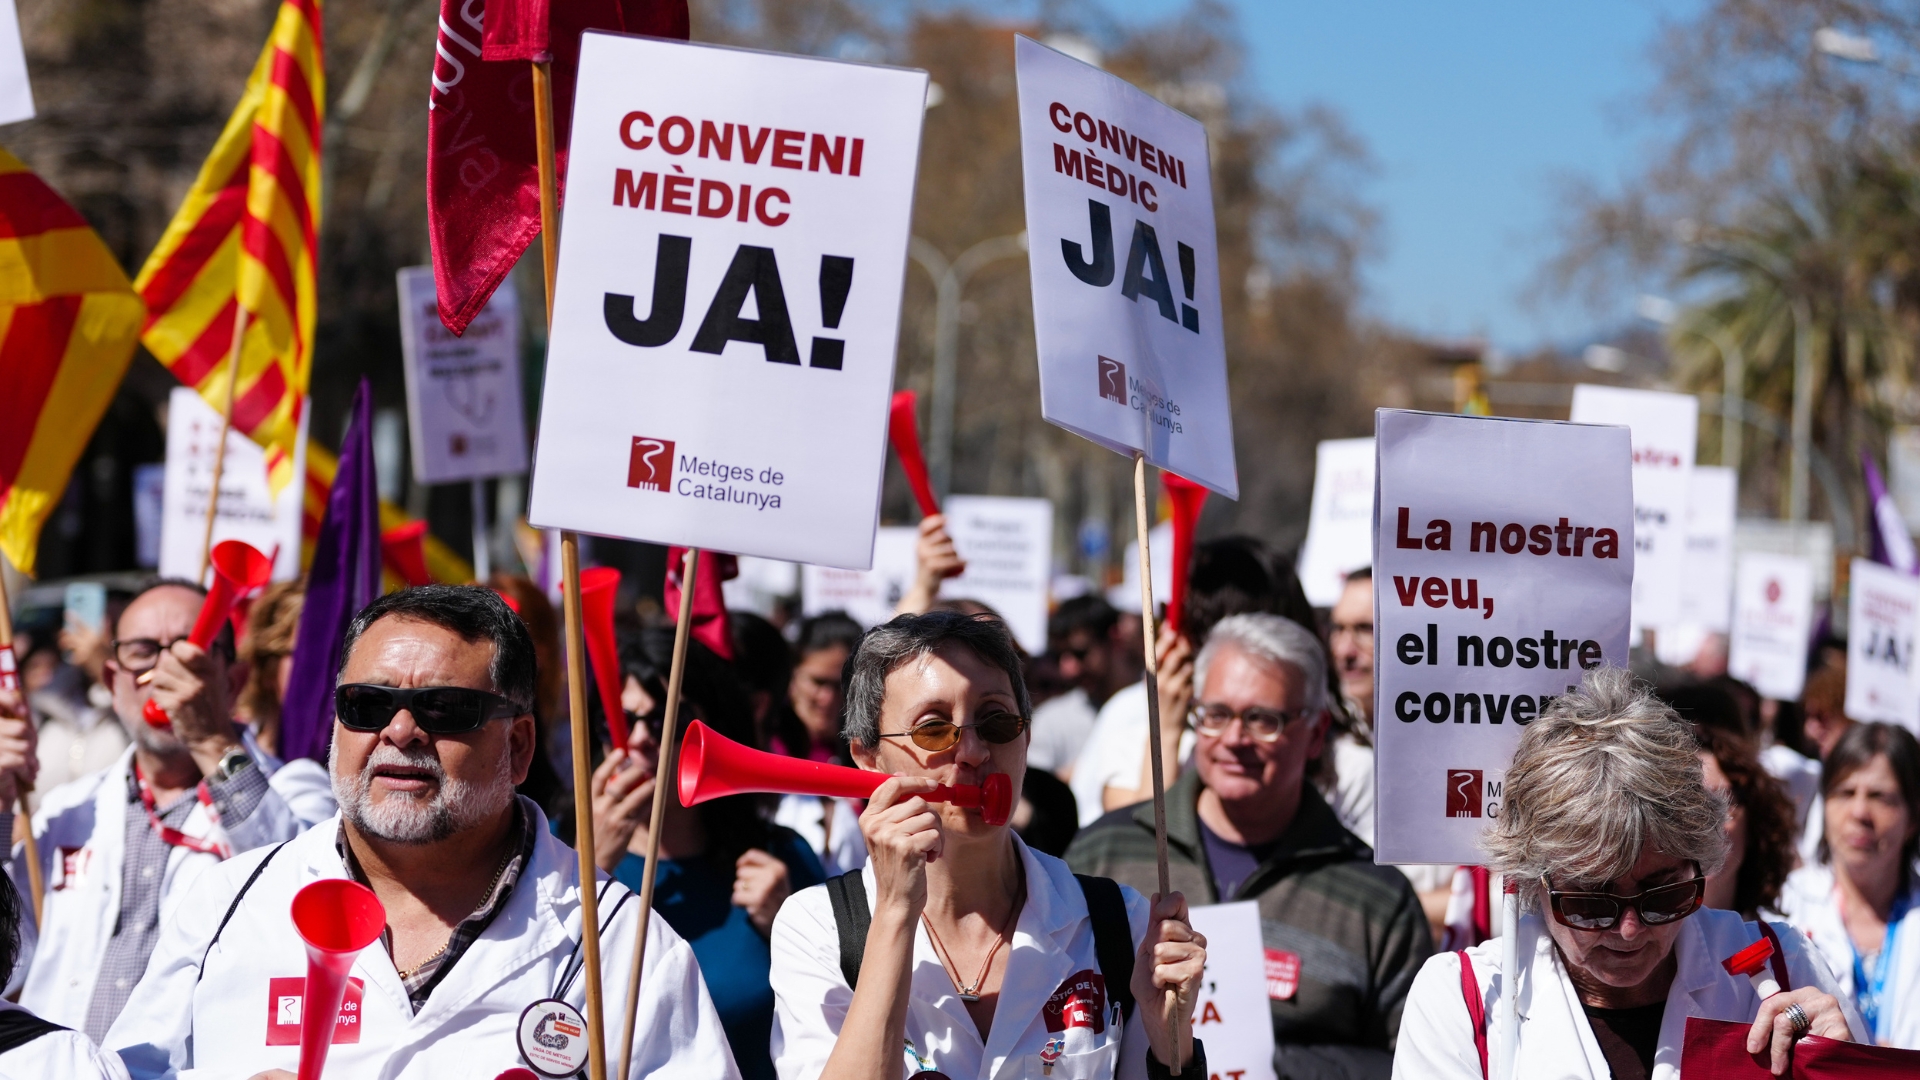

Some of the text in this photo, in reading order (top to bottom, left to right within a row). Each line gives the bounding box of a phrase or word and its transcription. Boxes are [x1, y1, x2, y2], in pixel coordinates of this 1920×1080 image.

[618, 111, 864, 177] CONVENI
[1049, 101, 1188, 190] CONVENI
[612, 164, 791, 227] MÈDIC
[1053, 143, 1159, 213] MÈDIC
[1060, 198, 1200, 335] JA!
[603, 233, 855, 371] JA!
[1166, 399, 1181, 416] de
[677, 478, 782, 511] Catalunya
[679, 454, 784, 486] Metges de
[1396, 506, 1452, 552] La
[1469, 517, 1620, 560] nostra
[1392, 575, 1494, 620] veu,
[1396, 623, 1602, 671] el nostre
[344, 1001, 357, 1011] de
[1075, 981, 1090, 991] DE
